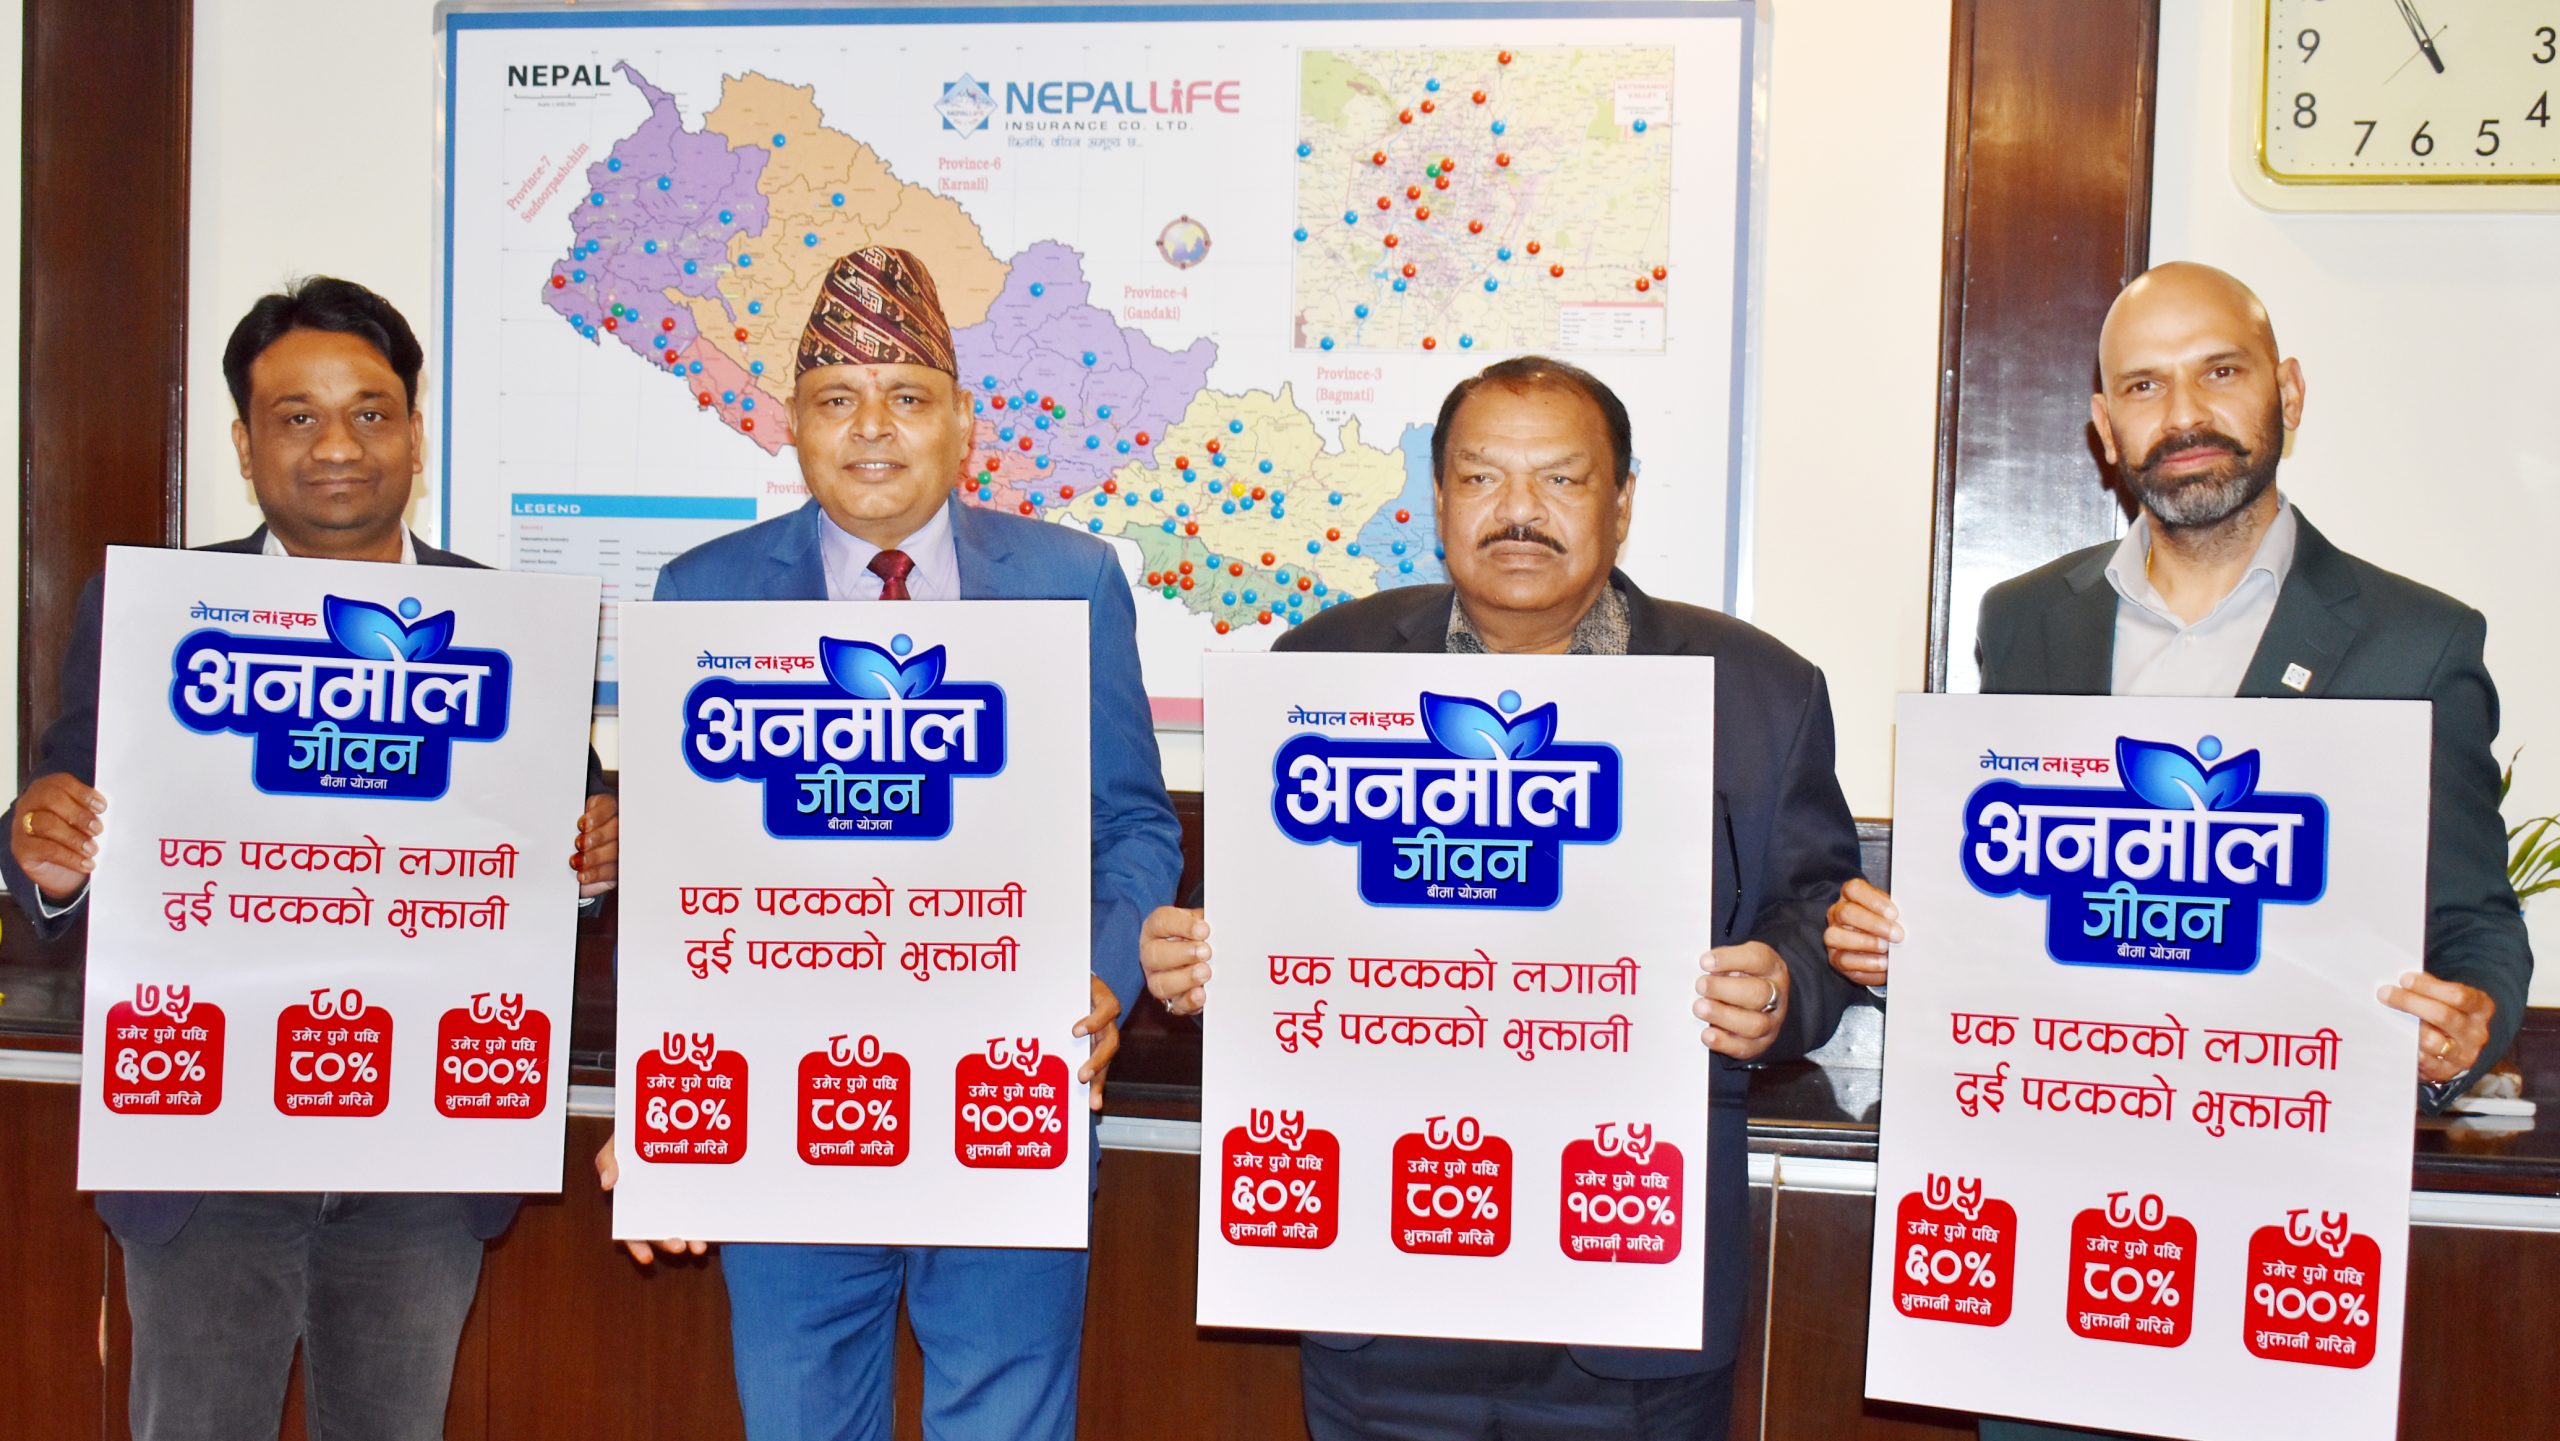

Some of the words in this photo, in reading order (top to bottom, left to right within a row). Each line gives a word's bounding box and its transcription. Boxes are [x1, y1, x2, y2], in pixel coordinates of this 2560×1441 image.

[2297, 29, 2320, 63] 9
[2532, 26, 2556, 64] 3
[508, 65, 610, 87] NEPAL
[2293, 92, 2317, 128] 8
[2525, 90, 2551, 127] 4
[1005, 121, 1107, 131] INSURANCE
[2353, 121, 2377, 156] 7
[2411, 121, 2434, 156] 6
[2475, 120, 2500, 156] 5
[938, 157, 1001, 171] Province-6
[507, 155, 551, 210] Province-7
[1124, 286, 1188, 300] Province-4
[1123, 306, 1181, 321] (Gandaki)
[1316, 366, 1382, 381] Province-3
[1316, 387, 1375, 405] (Bagmati)
[514, 503, 581, 515] LEGEND
[190, 601, 249, 623] नेपाल
[253, 609, 318, 629] लाइफ
[697, 650, 751, 670] नेपाल
[754, 655, 815, 674] लाइफ
[184, 632, 491, 726] अनमोल
[696, 671, 986, 762] अनमोल
[1287, 705, 1346, 726] नेपाल
[1349, 711, 1415, 731] लाइफ
[289, 720, 424, 775] जीवन
[1980, 749, 2039, 772] नेपाल
[2043, 757, 2110, 777] लाइफ
[320, 774, 346, 788] बीमा
[351, 775, 388, 789] योजना
[795, 763, 926, 815] जीवन
[1286, 729, 1600, 828] अनमोल
[828, 817, 853, 830] बीमा
[857, 816, 892, 831] योजना
[1975, 777, 2304, 886] अनमोल
[159, 838, 226, 868] एक
[240, 834, 386, 874] पटकको
[399, 843, 519, 878] लगानी
[1393, 826, 1533, 883] जीवन
[679, 887, 742, 916] एक
[755, 876, 894, 917] पटकको
[907, 881, 1027, 918] लगानी
[1427, 884, 1454, 898] बीमा
[1458, 884, 1497, 900] योजना
[162, 881, 217, 931] दुई
[228, 887, 374, 926] पटकको
[387, 895, 509, 938] भुक्तानी
[2083, 881, 2230, 943] जीवन
[685, 927, 736, 980] दुई
[747, 930, 887, 971] पटकको
[900, 935, 1021, 982] भुक्तानी
[2117, 942, 2145, 958] बीमा
[2150, 943, 2191, 961] योजना
[1268, 955, 1334, 986] एक
[1348, 948, 1498, 991] पटकको
[1512, 956, 1641, 995] लगानी
[136, 983, 190, 1018] ७५
[471, 992, 523, 1026] ८५
[117, 1025, 148, 1039] उमेर
[154, 1026, 176, 1043] पुगे
[182, 1026, 208, 1041] पछि
[292, 1027, 321, 1042] उमेर
[328, 1028, 348, 1045] पुगे
[354, 1028, 380, 1043] पछि
[451, 1036, 480, 1050] उमेर
[486, 1037, 506, 1054] पुगे
[511, 1037, 537, 1051] पछि
[1273, 999, 1328, 1053] दुई
[1339, 1005, 1488, 1049] पटकको
[1503, 1013, 1633, 1061] भुक्तानी
[1951, 1012, 2019, 1046] एक
[2032, 1013, 2189, 1060] पटकको
[2204, 1028, 2342, 1070] लगानी
[663, 1032, 714, 1068] ७५
[986, 1037, 1039, 1072] ८५
[115, 1048, 205, 1084] ६०%
[290, 1051, 378, 1083] ८०%
[443, 1056, 541, 1085] १००%
[647, 1073, 676, 1089] उमेर
[681, 1074, 702, 1092] पुगे
[707, 1074, 733, 1090] पछि
[812, 1074, 842, 1089] उमेर
[847, 1075, 867, 1093] पुगे
[872, 1075, 898, 1091] पछि
[968, 1082, 998, 1098] उमेर
[1003, 1083, 1024, 1101] पुगे
[1029, 1083, 1056, 1098] पछि
[112, 1090, 160, 1107] भुक्तानी
[166, 1091, 202, 1105] गरिने
[286, 1091, 332, 1108] भुक्तानी
[339, 1092, 374, 1106] गरिने
[445, 1093, 491, 1109] भुक्तानी
[496, 1093, 530, 1107] गरिने
[1954, 1061, 2010, 1117] दुई
[2022, 1074, 2176, 1120] पटकको
[2192, 1090, 2331, 1137] भुक्तानी
[645, 1096, 731, 1134] ६०%
[811, 1099, 898, 1131] ८०%
[962, 1103, 1062, 1133] १००%
[1250, 1108, 1304, 1147] ७५
[643, 1139, 689, 1157] भुक्तानी
[694, 1139, 728, 1154] गरिने
[809, 1140, 855, 1158] भुक्तानी
[860, 1140, 894, 1156] गरिने
[966, 1141, 1012, 1159] भुक्तानी
[1017, 1142, 1052, 1157] गरिने
[1595, 1121, 1651, 1159] ८५
[1233, 1152, 1263, 1168] उमेर
[1269, 1153, 1291, 1172] पुगे
[1296, 1154, 1323, 1170] पछि
[1408, 1157, 1438, 1174] उमेर
[1444, 1159, 1466, 1178] पुगे
[1472, 1159, 1499, 1177] पछि
[1232, 1175, 1321, 1214] ६०%
[1575, 1170, 1607, 1187] उमेर
[1612, 1171, 1635, 1190] पुगे
[1640, 1172, 1669, 1189] पछि
[1927, 1173, 1982, 1218] ७५
[1406, 1183, 1498, 1219] ८०%
[1568, 1192, 1675, 1225] १००%
[1229, 1221, 1277, 1240] भुक्तानी
[1282, 1222, 1318, 1239] गरिने
[1404, 1228, 1452, 1246] भुक्तानी
[1458, 1228, 1495, 1245] गरिने
[1571, 1234, 1621, 1252] भुक्तानी
[1627, 1234, 1664, 1251] गरिने
[1908, 1219, 1939, 1236] उमेर
[1944, 1222, 1966, 1242] पुगे
[1972, 1224, 2000, 1243] पछि
[2287, 1208, 2347, 1255] ८५
[2087, 1235, 2119, 1253] उमेर
[2124, 1239, 2147, 1259] पुगे
[2154, 1242, 2182, 1260] पछि
[1905, 1244, 1996, 1288] ६०%
[2262, 1260, 2297, 1278] उमेर
[2303, 1264, 2327, 1285] पुगे
[2333, 1266, 2365, 1286] पछि
[2084, 1261, 2180, 1307] ८०%
[1901, 1293, 1949, 1311] भुक्तानी
[1955, 1297, 1992, 1315] गरिने
[2253, 1283, 2370, 1327] १००%
[2079, 1311, 2131, 1331] भुक्तानी
[2136, 1316, 2174, 1335] गरिने
[2256, 1330, 2309, 1349] भुक्तानी
[2315, 1335, 2356, 1355] गरिने
